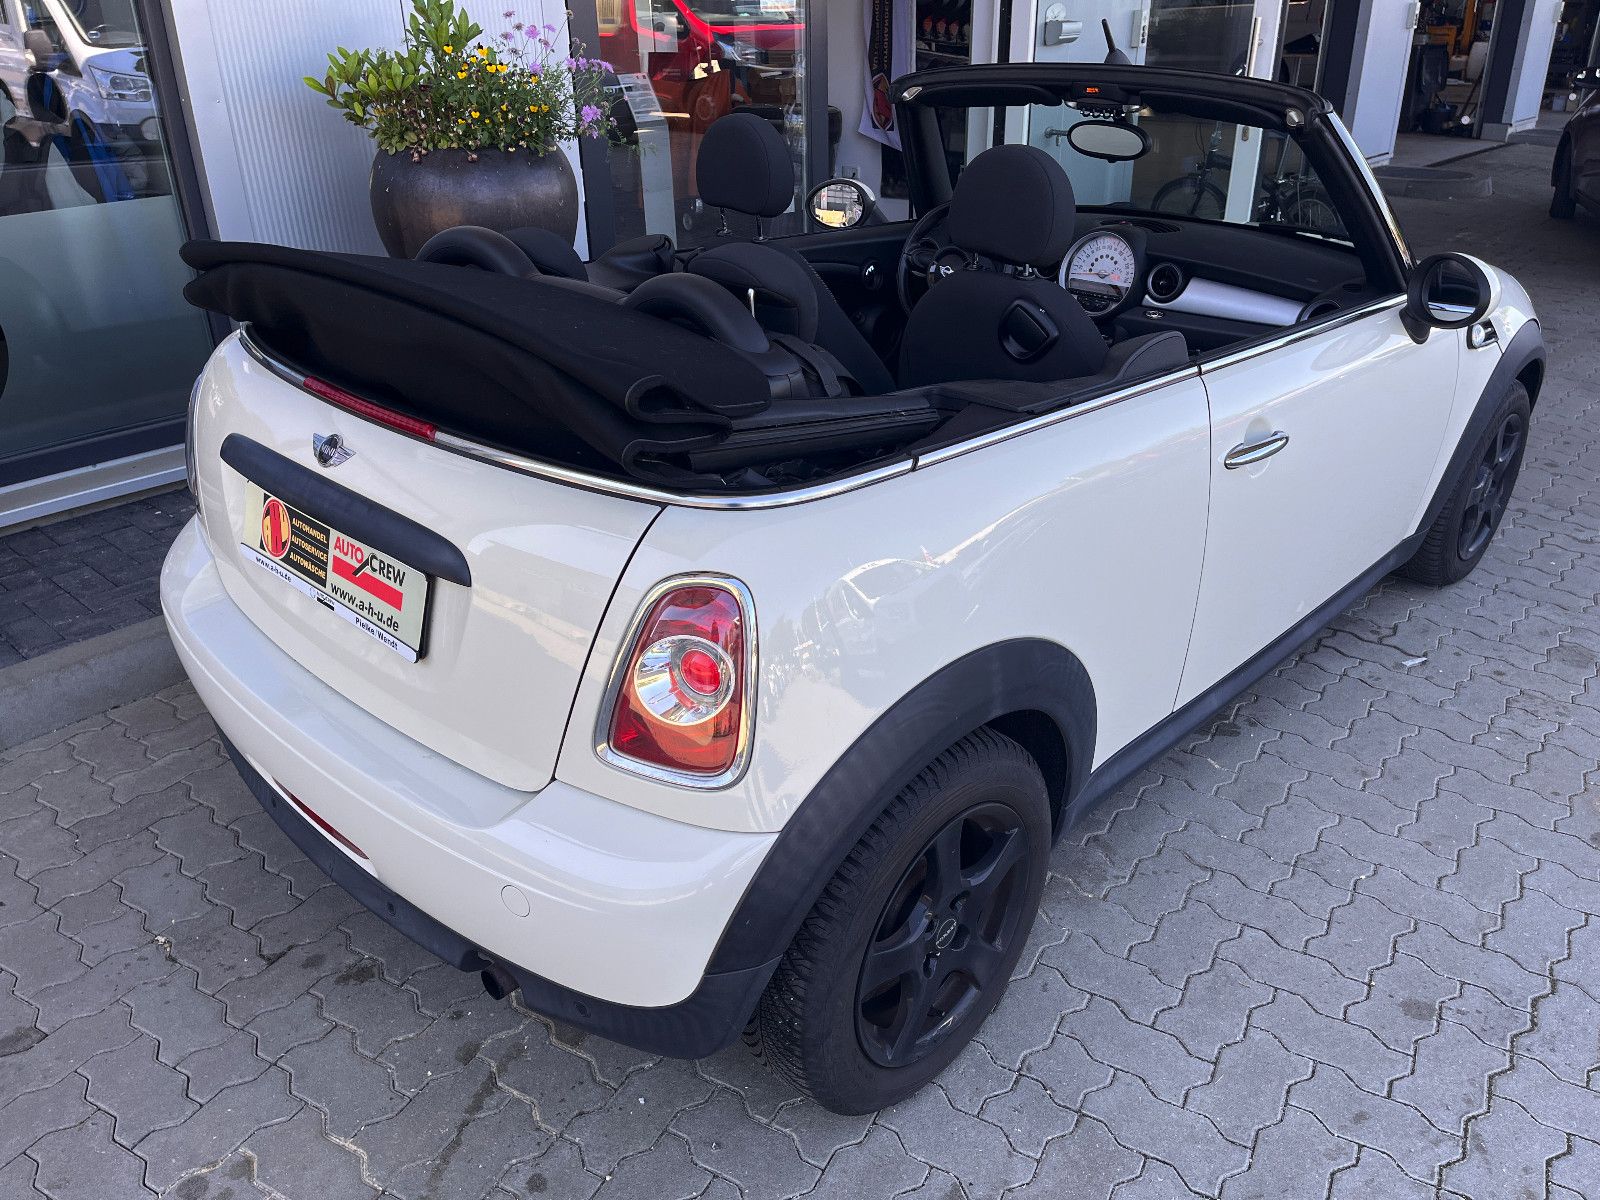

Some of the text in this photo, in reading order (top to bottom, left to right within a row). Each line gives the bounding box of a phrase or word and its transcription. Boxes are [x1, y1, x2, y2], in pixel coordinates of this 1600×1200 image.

[292, 517, 328, 544] AUTOHANDEL
[291, 534, 328, 562] AUTOSERVICE
[334, 536, 406, 587] AUTO CREW
[289, 551, 327, 580] AUTOWÄSCHE
[330, 582, 399, 632] www.a-h-u.de
